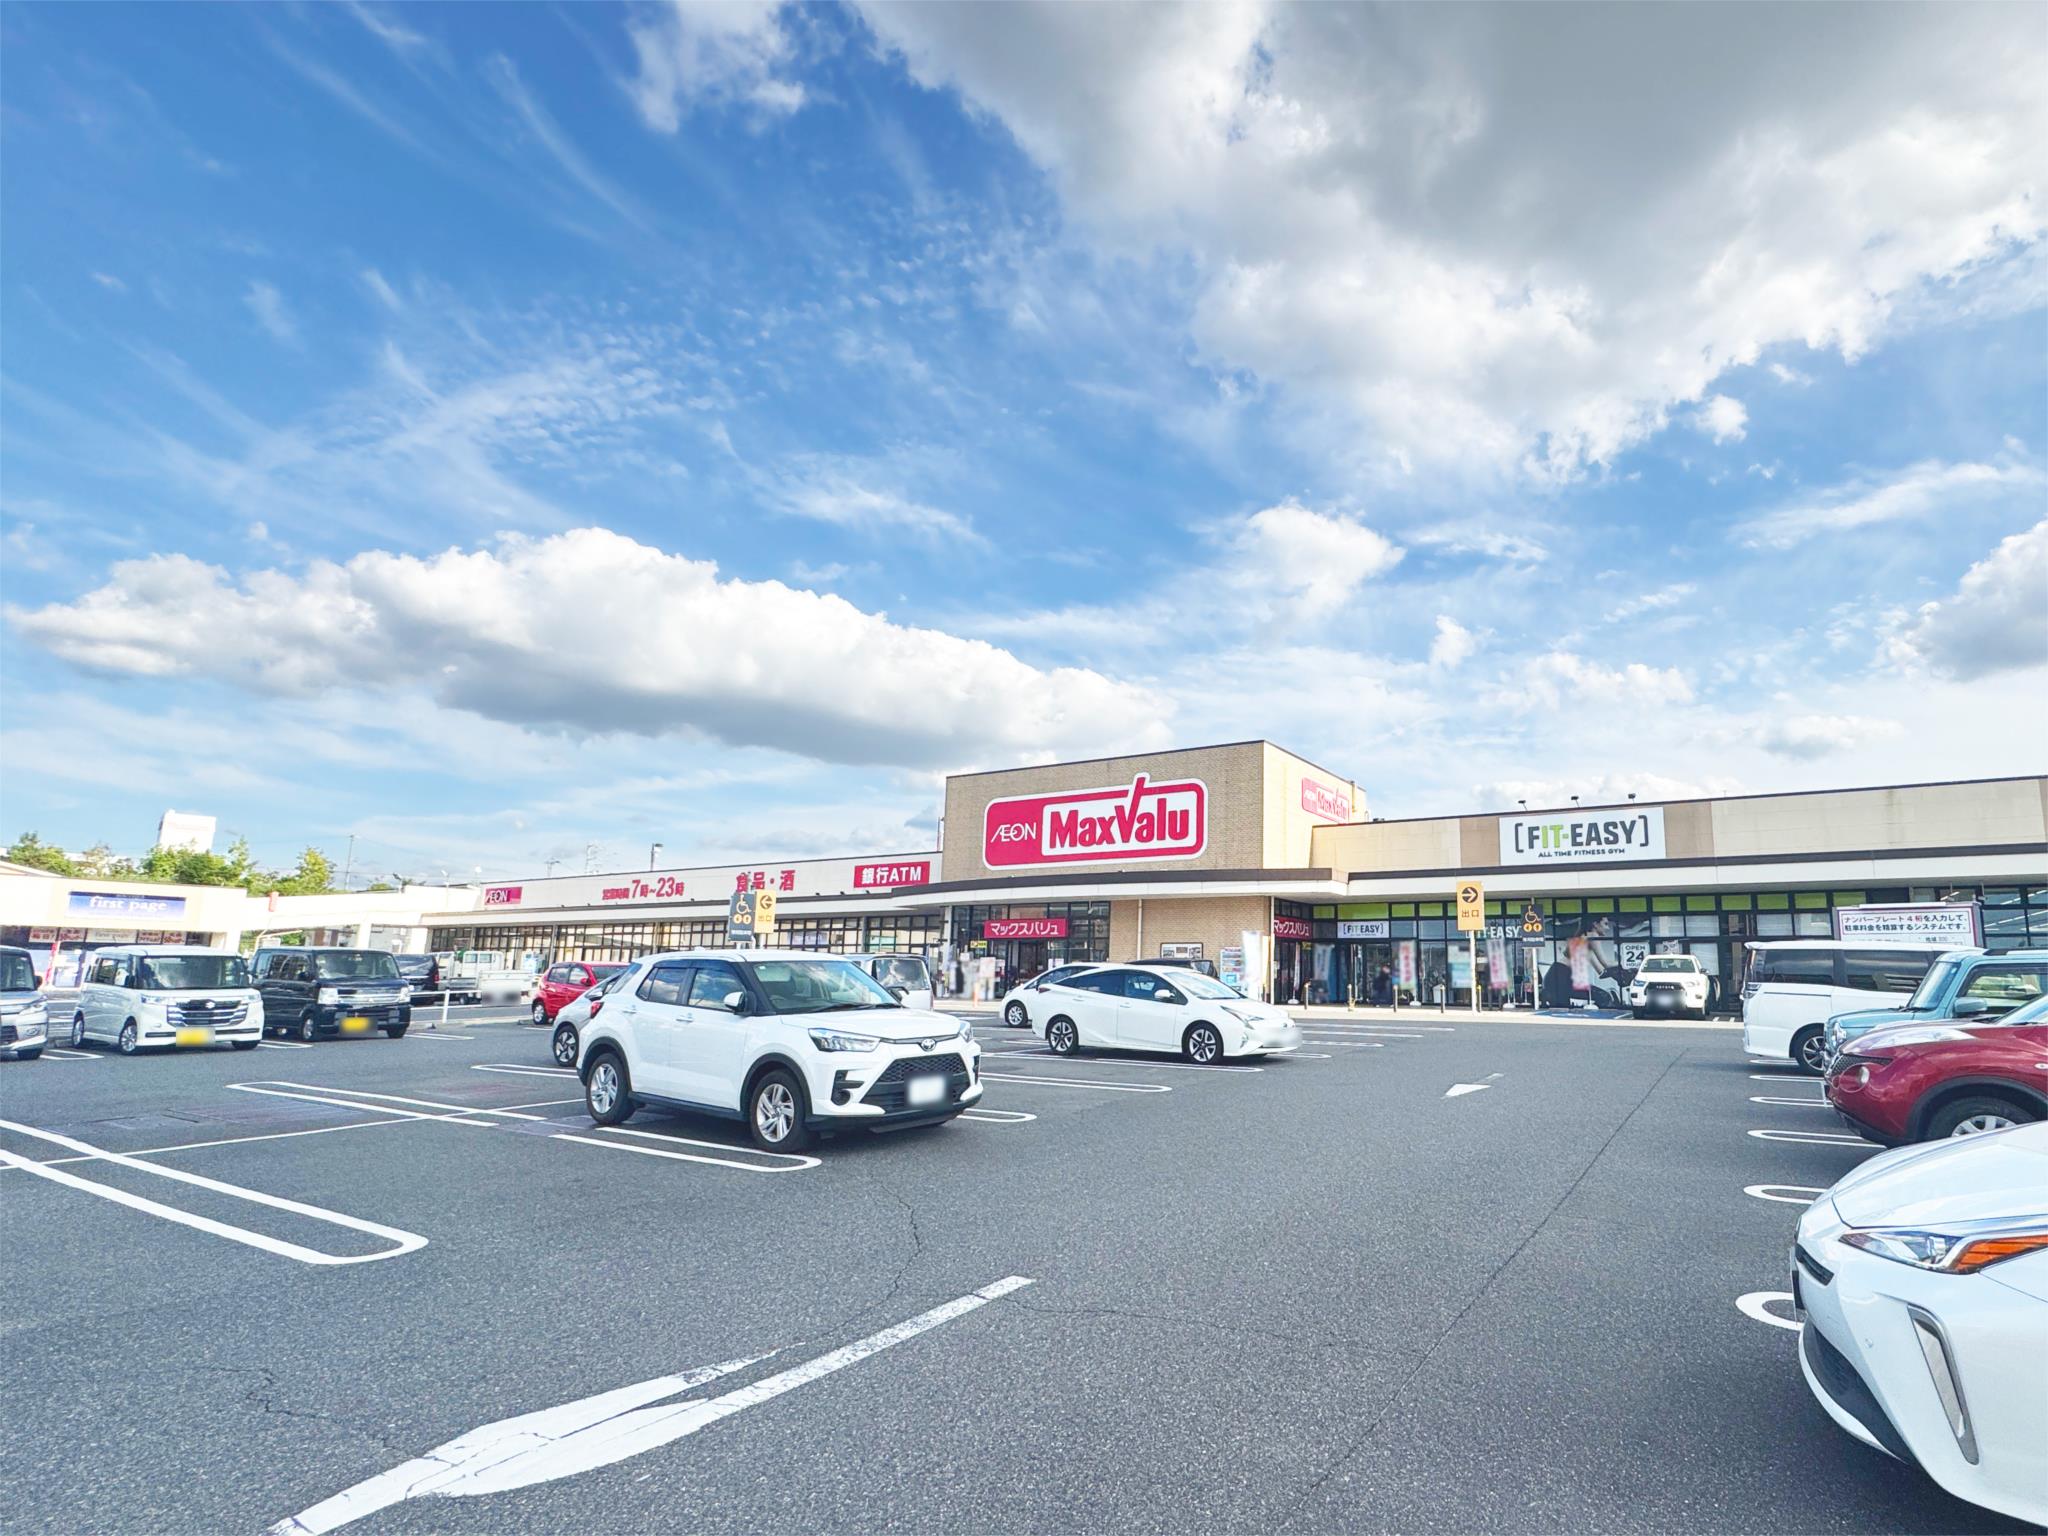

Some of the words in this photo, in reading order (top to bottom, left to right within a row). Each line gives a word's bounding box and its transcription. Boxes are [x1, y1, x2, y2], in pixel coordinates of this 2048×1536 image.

[1049, 777, 1189, 849] MaxValu
[128, 901, 168, 913] page
[1462, 909, 1479, 918] 出口
[990, 921, 1059, 936] マックスバリュ
[1626, 951, 1645, 962] 24
